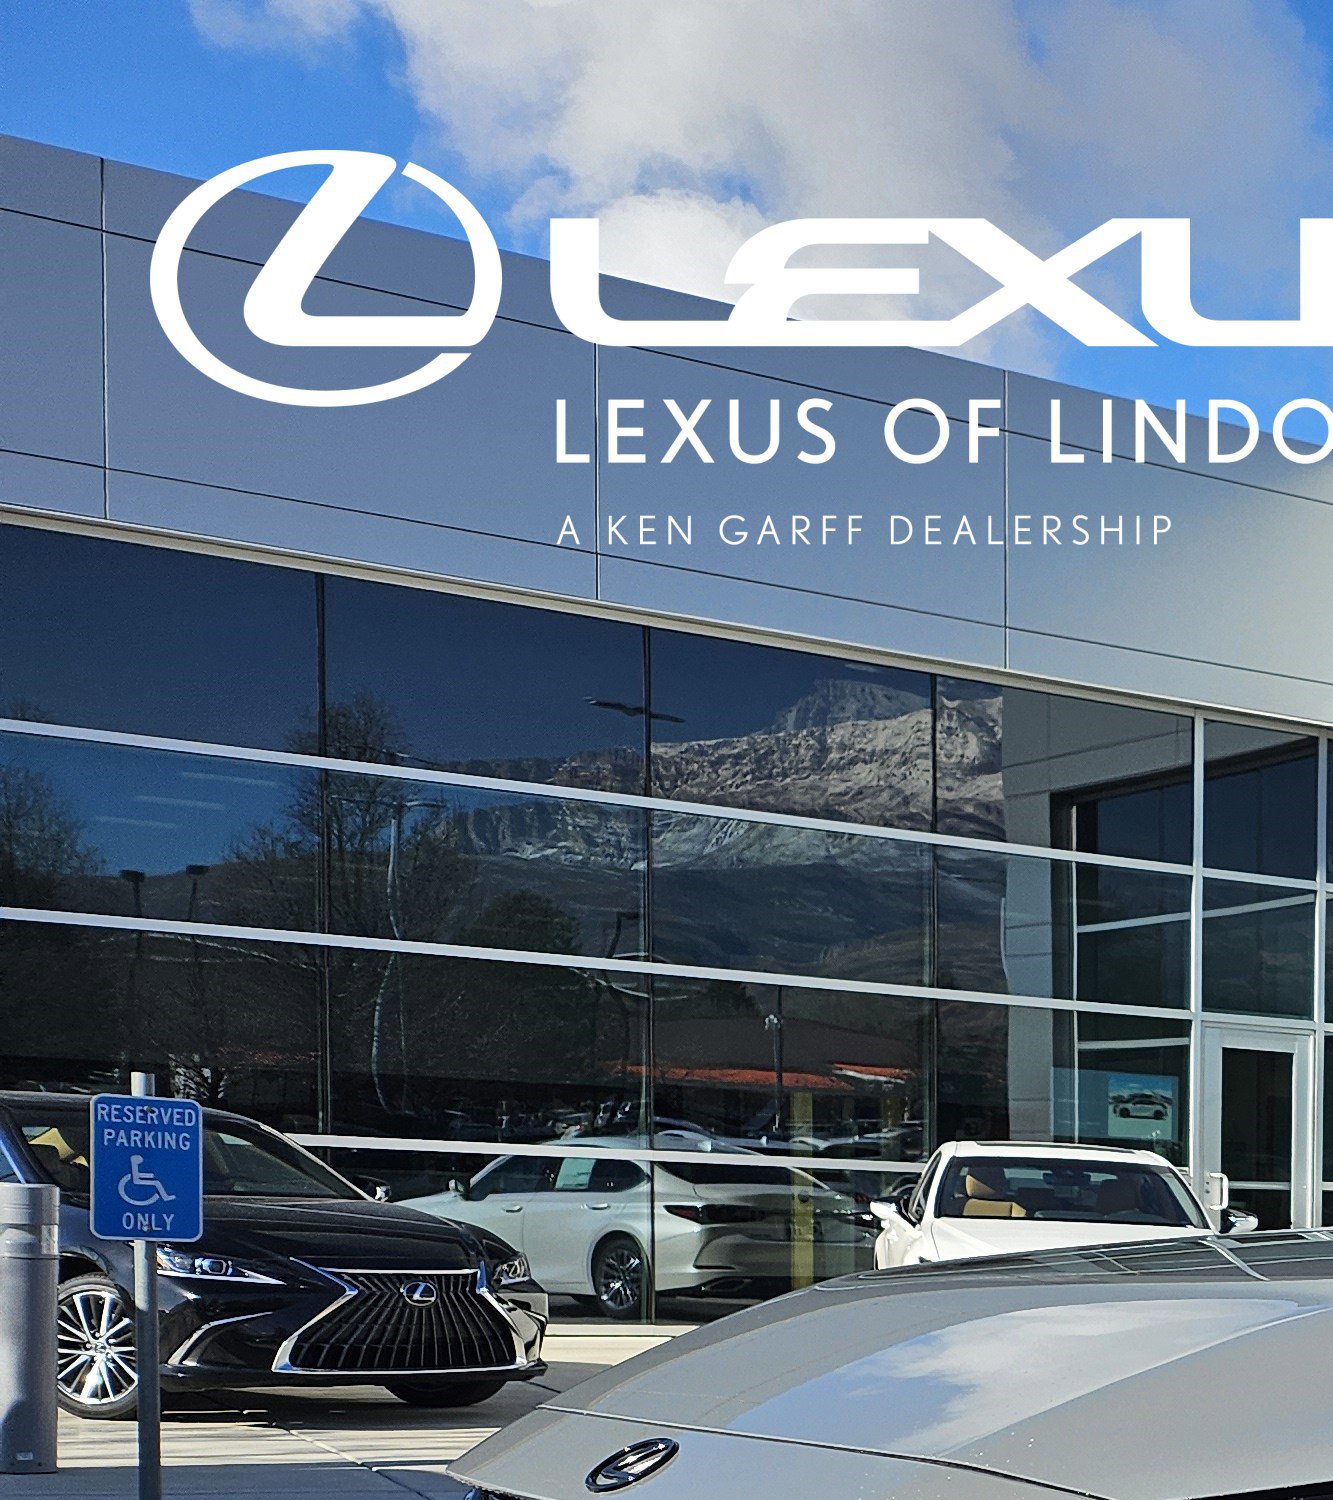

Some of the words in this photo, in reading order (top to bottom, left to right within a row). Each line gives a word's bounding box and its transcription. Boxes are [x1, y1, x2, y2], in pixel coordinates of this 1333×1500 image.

[97, 1103, 196, 1127] RESERVED
[103, 1128, 191, 1151] PARKING
[122, 1211, 175, 1232] ONLY
